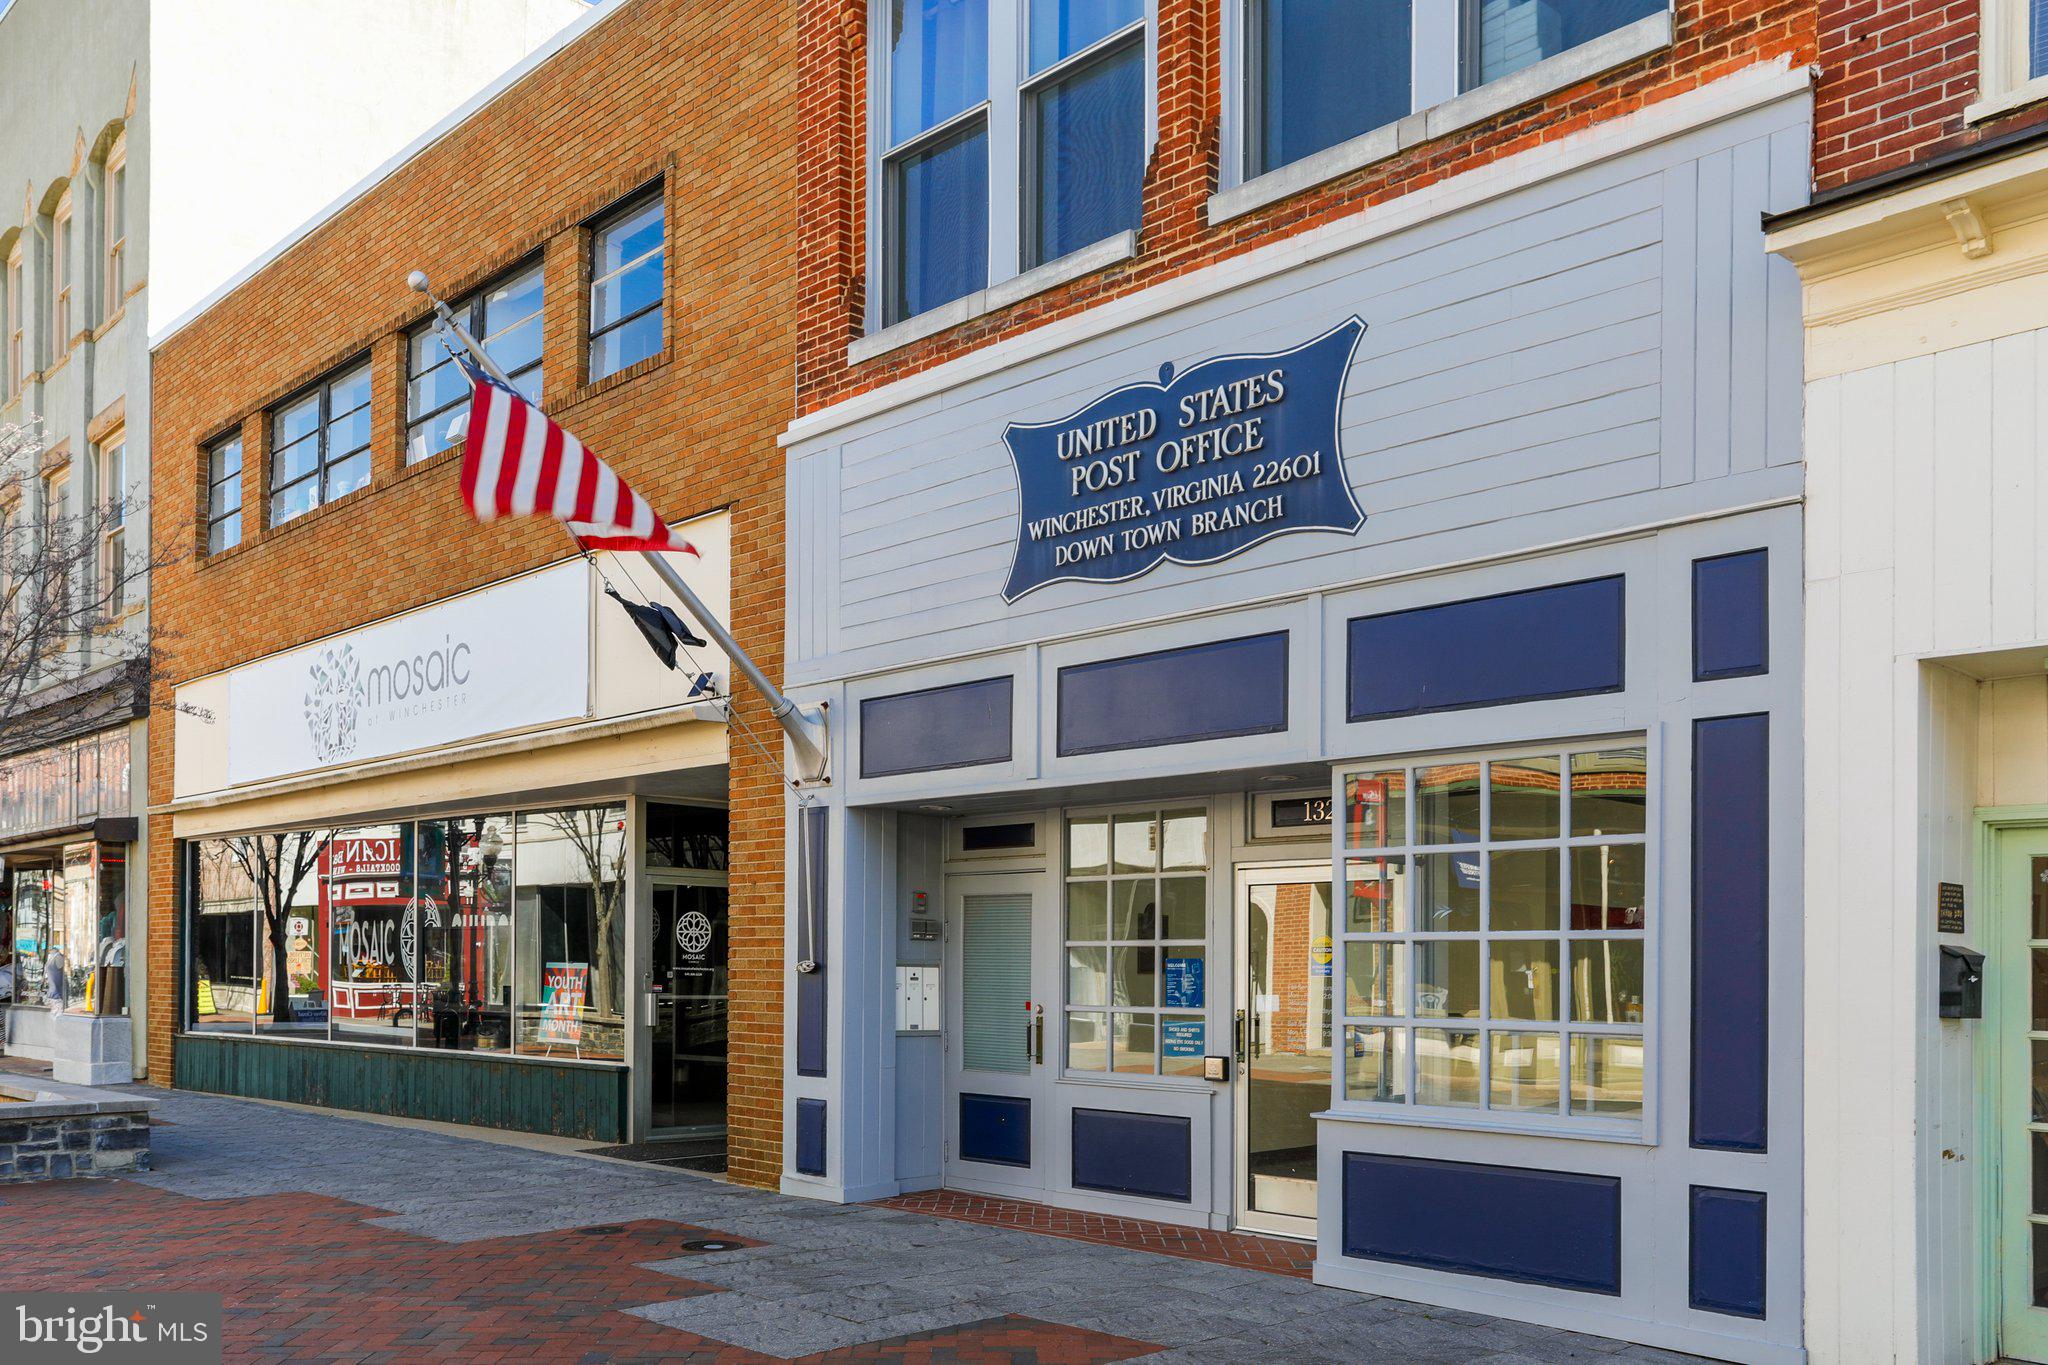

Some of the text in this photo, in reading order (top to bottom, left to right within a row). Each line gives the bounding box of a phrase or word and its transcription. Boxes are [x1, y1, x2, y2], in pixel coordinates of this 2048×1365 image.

[1057, 369, 1285, 461] UNITED STATES
[1071, 417, 1265, 497] POST OFFICE
[1027, 450, 1321, 542] WINCHESTER, VIRGINIA 22601
[1055, 495, 1284, 567] DOWN TOWN BRANCH
[367, 634, 471, 707] mosaic
[389, 697, 468, 721] WINCHESTER
[1303, 800, 1333, 821] 132
[340, 919, 395, 965] MOSAIC
[545, 991, 583, 1016] ART
[548, 975, 583, 990] YOUTH
[542, 1019, 578, 1032] MONTH
